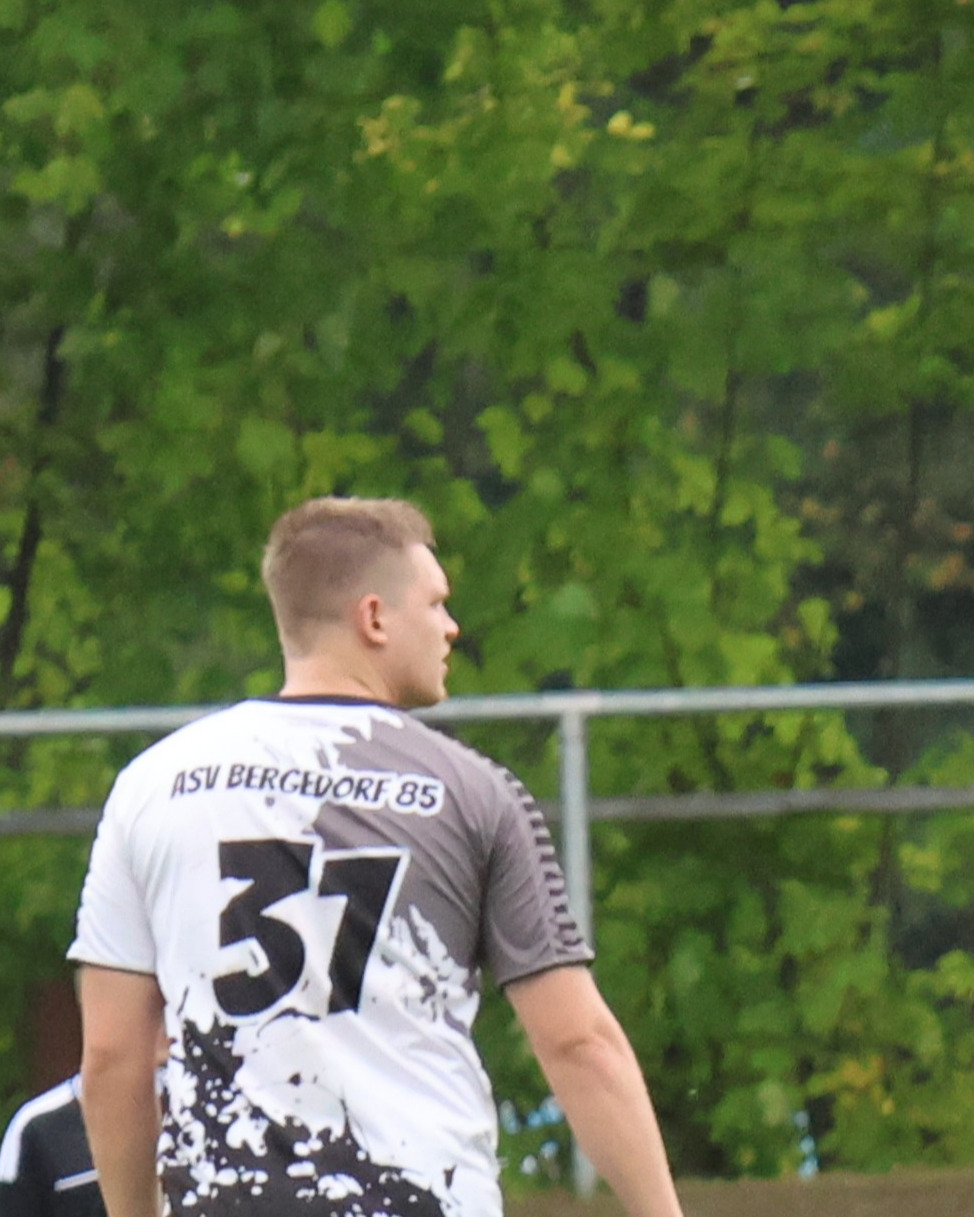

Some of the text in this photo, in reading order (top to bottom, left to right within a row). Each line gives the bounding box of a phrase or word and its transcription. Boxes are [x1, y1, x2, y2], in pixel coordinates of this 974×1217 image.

[171, 763, 440, 810] ASV BERGEDORF 85
[212, 839, 402, 1017] 37
